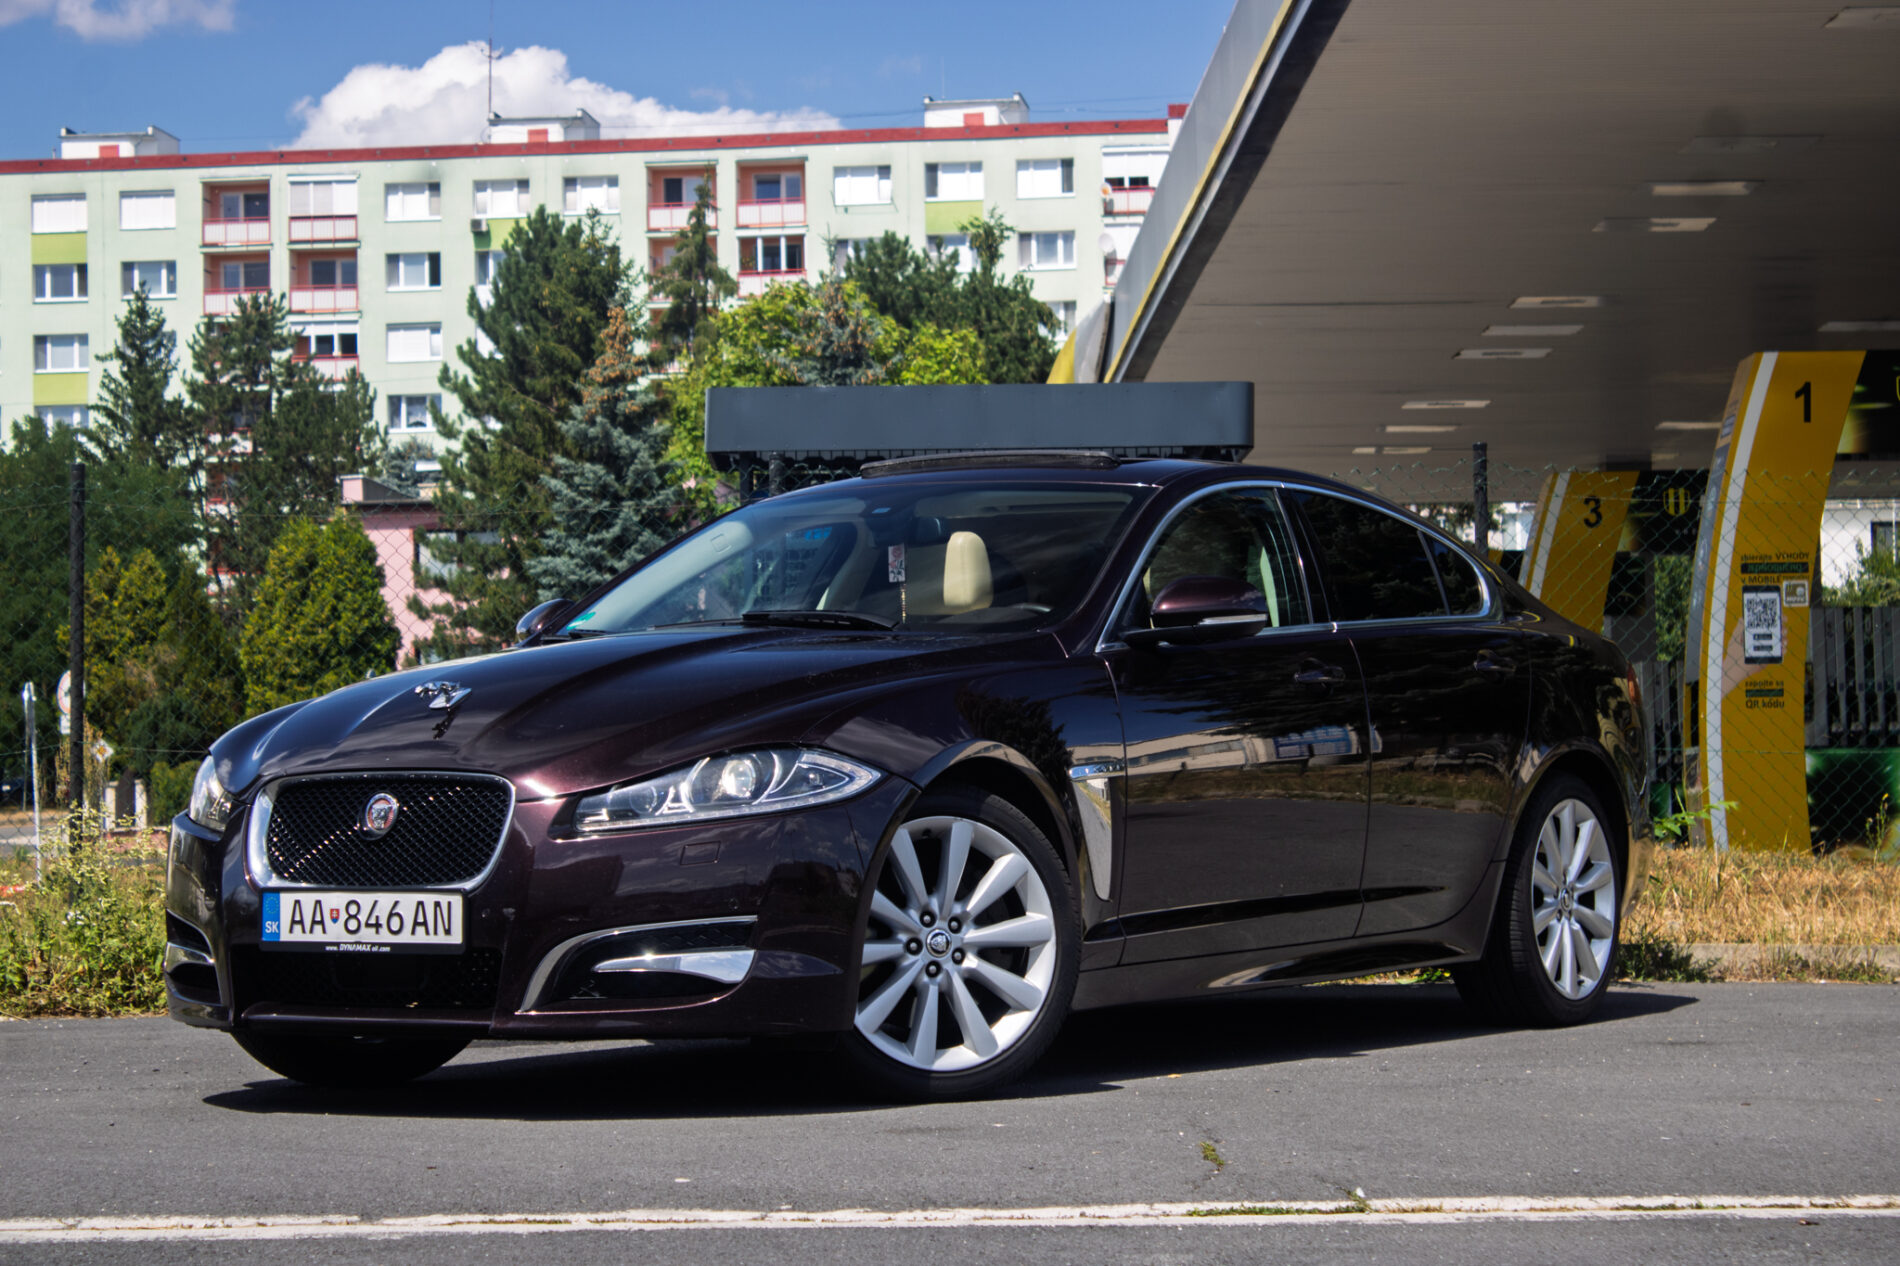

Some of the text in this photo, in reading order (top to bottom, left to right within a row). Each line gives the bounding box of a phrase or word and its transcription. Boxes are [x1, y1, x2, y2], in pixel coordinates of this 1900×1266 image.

[1795, 381, 1812, 423] 1
[1583, 496, 1602, 528] 3
[264, 921, 279, 933] SK
[288, 899, 327, 935] AA
